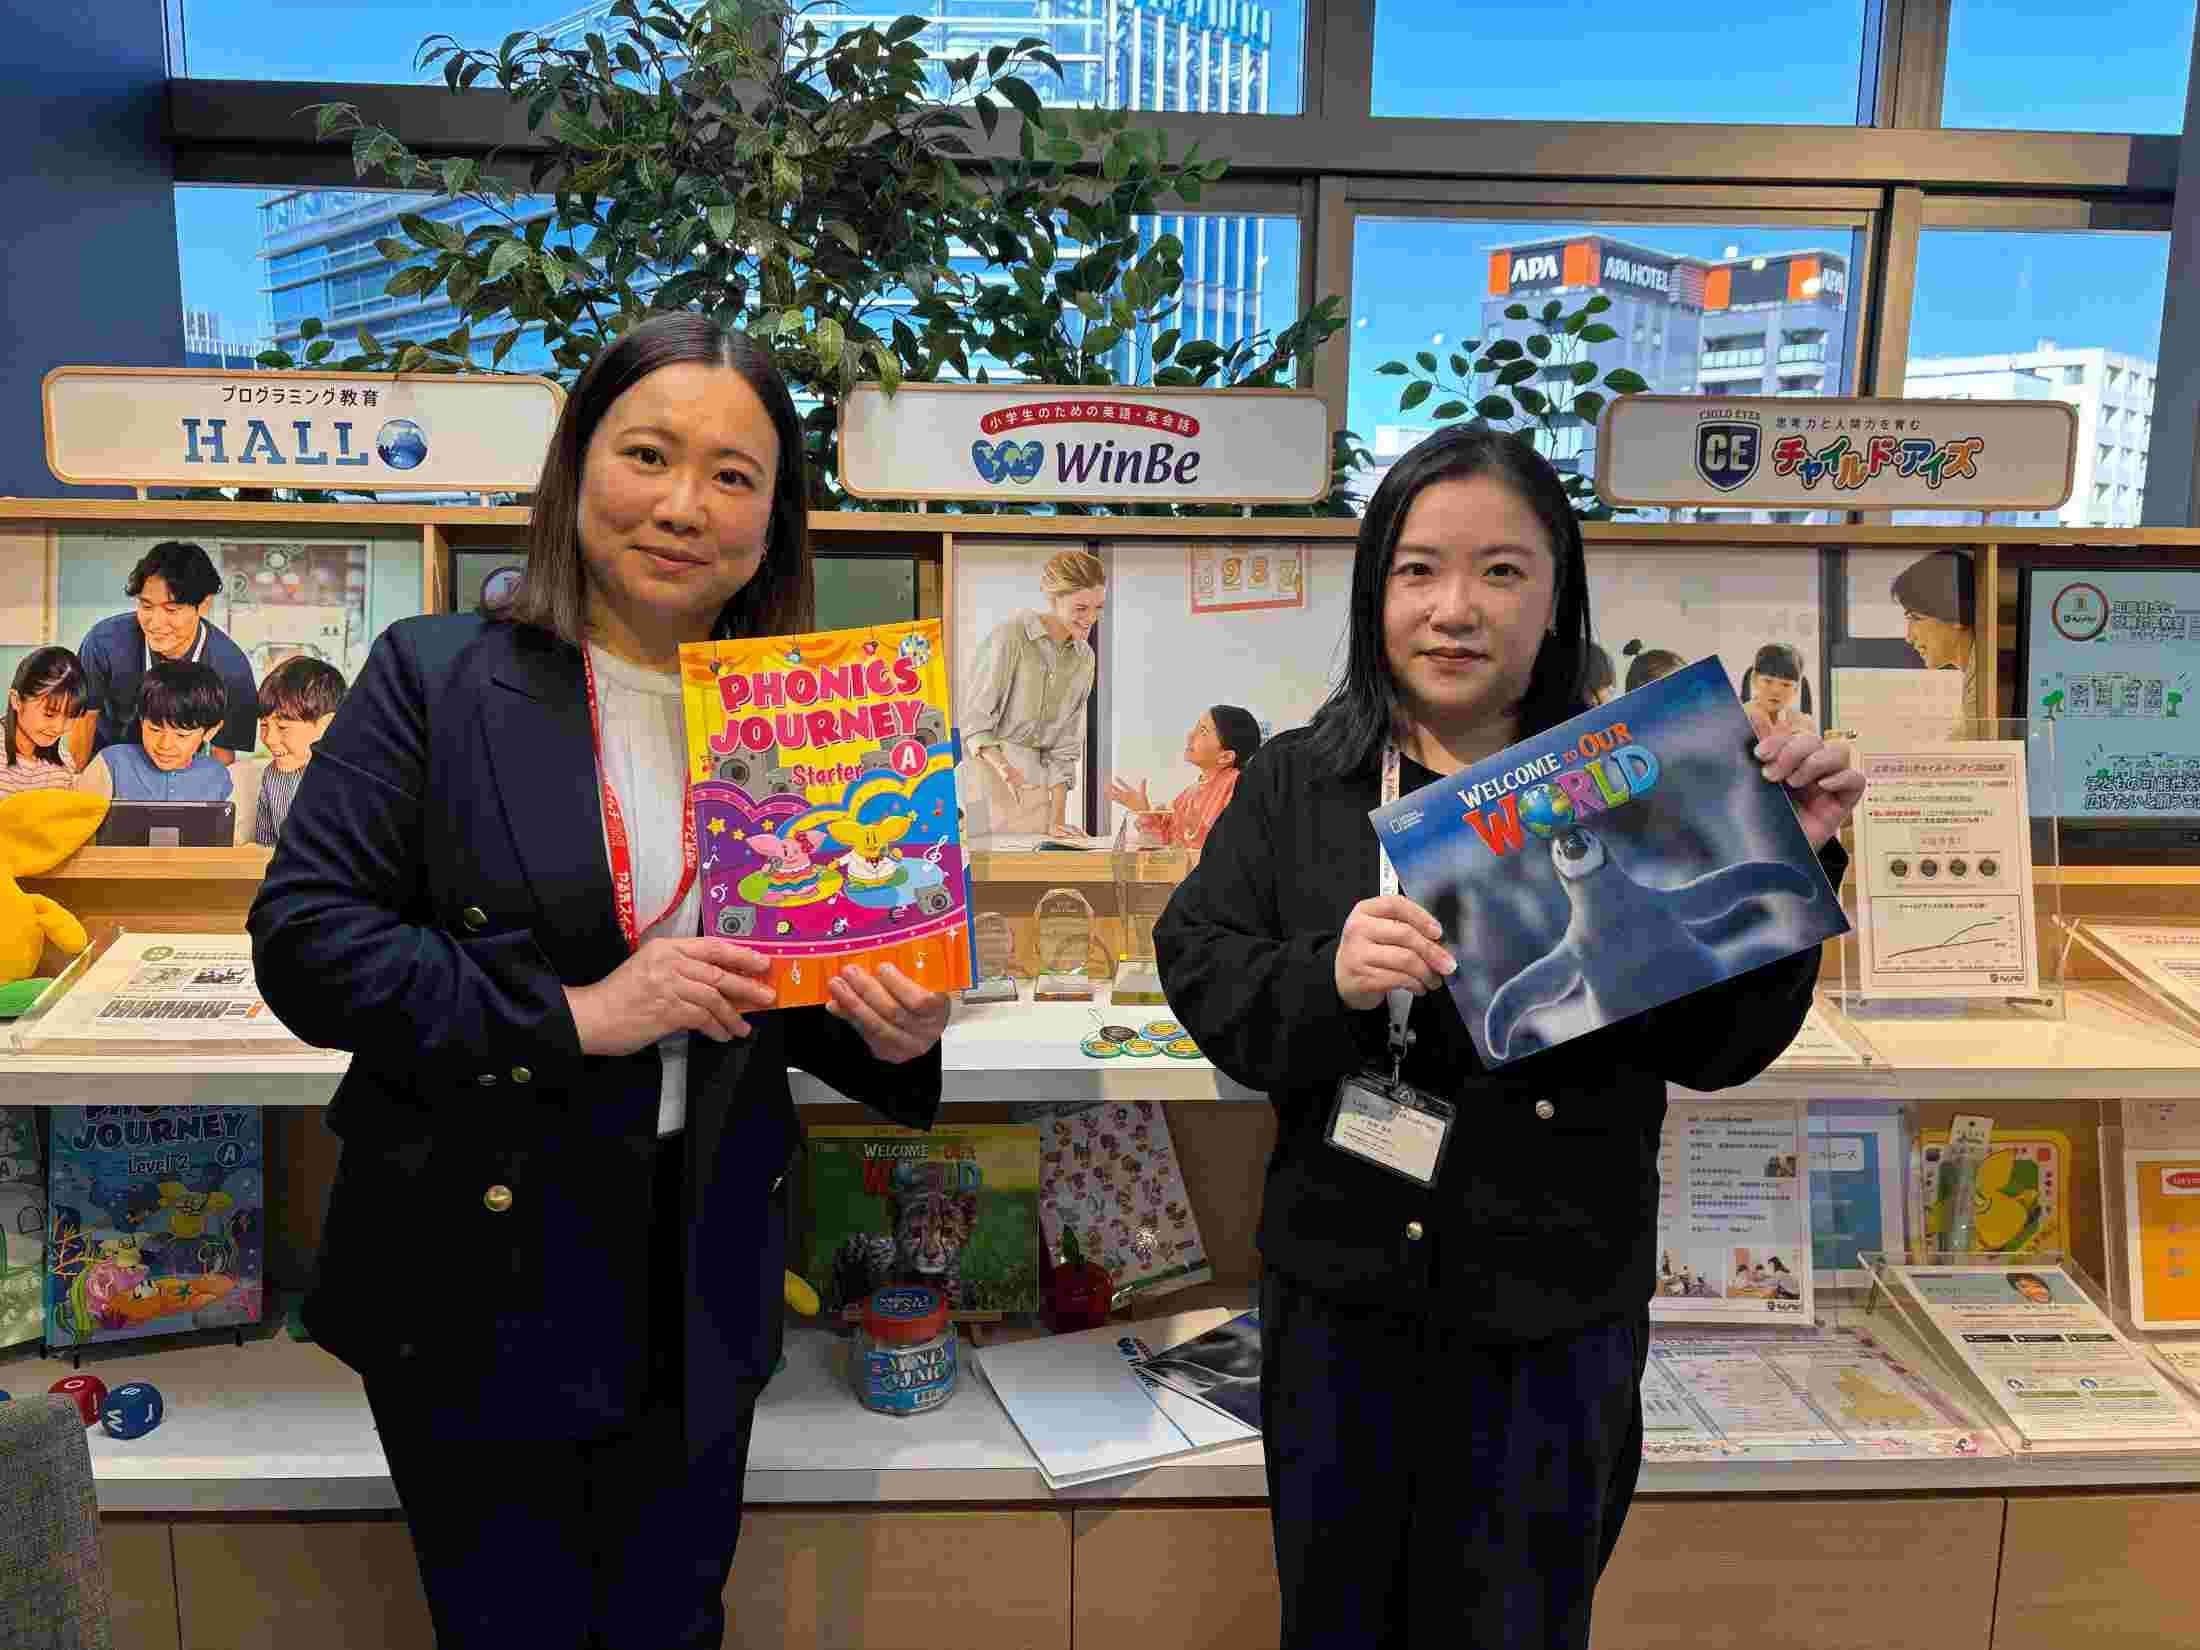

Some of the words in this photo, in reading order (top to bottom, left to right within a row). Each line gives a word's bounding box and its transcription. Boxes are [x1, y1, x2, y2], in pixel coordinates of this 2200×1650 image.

[1511, 255, 1558, 283] APA
[1604, 256, 1630, 283] APA
[1630, 264, 1670, 292] HOTEL
[222, 386, 380, 408] プログラミング教育
[989, 404, 1192, 433] 小学生のための英語・英会話
[1776, 416, 1921, 432] 思考力と人間力を育む
[1055, 440, 1200, 484] WinBe
[1704, 434, 1751, 472] CE
[1772, 435, 1985, 489] チャイルド・アイズ
[719, 657, 921, 712] PHONICS
[708, 700, 927, 755] JOURNEY
[790, 760, 865, 785] Starter
[903, 746, 917, 771] A
[1457, 752, 1561, 809] WELCOME
[1577, 722, 1633, 758] OUR
[1462, 745, 1661, 857] WORLD
[72, 1111, 248, 1151] JOURNEY
[128, 1152, 171, 1175] Level
[863, 1143, 929, 1161] WELCOME
